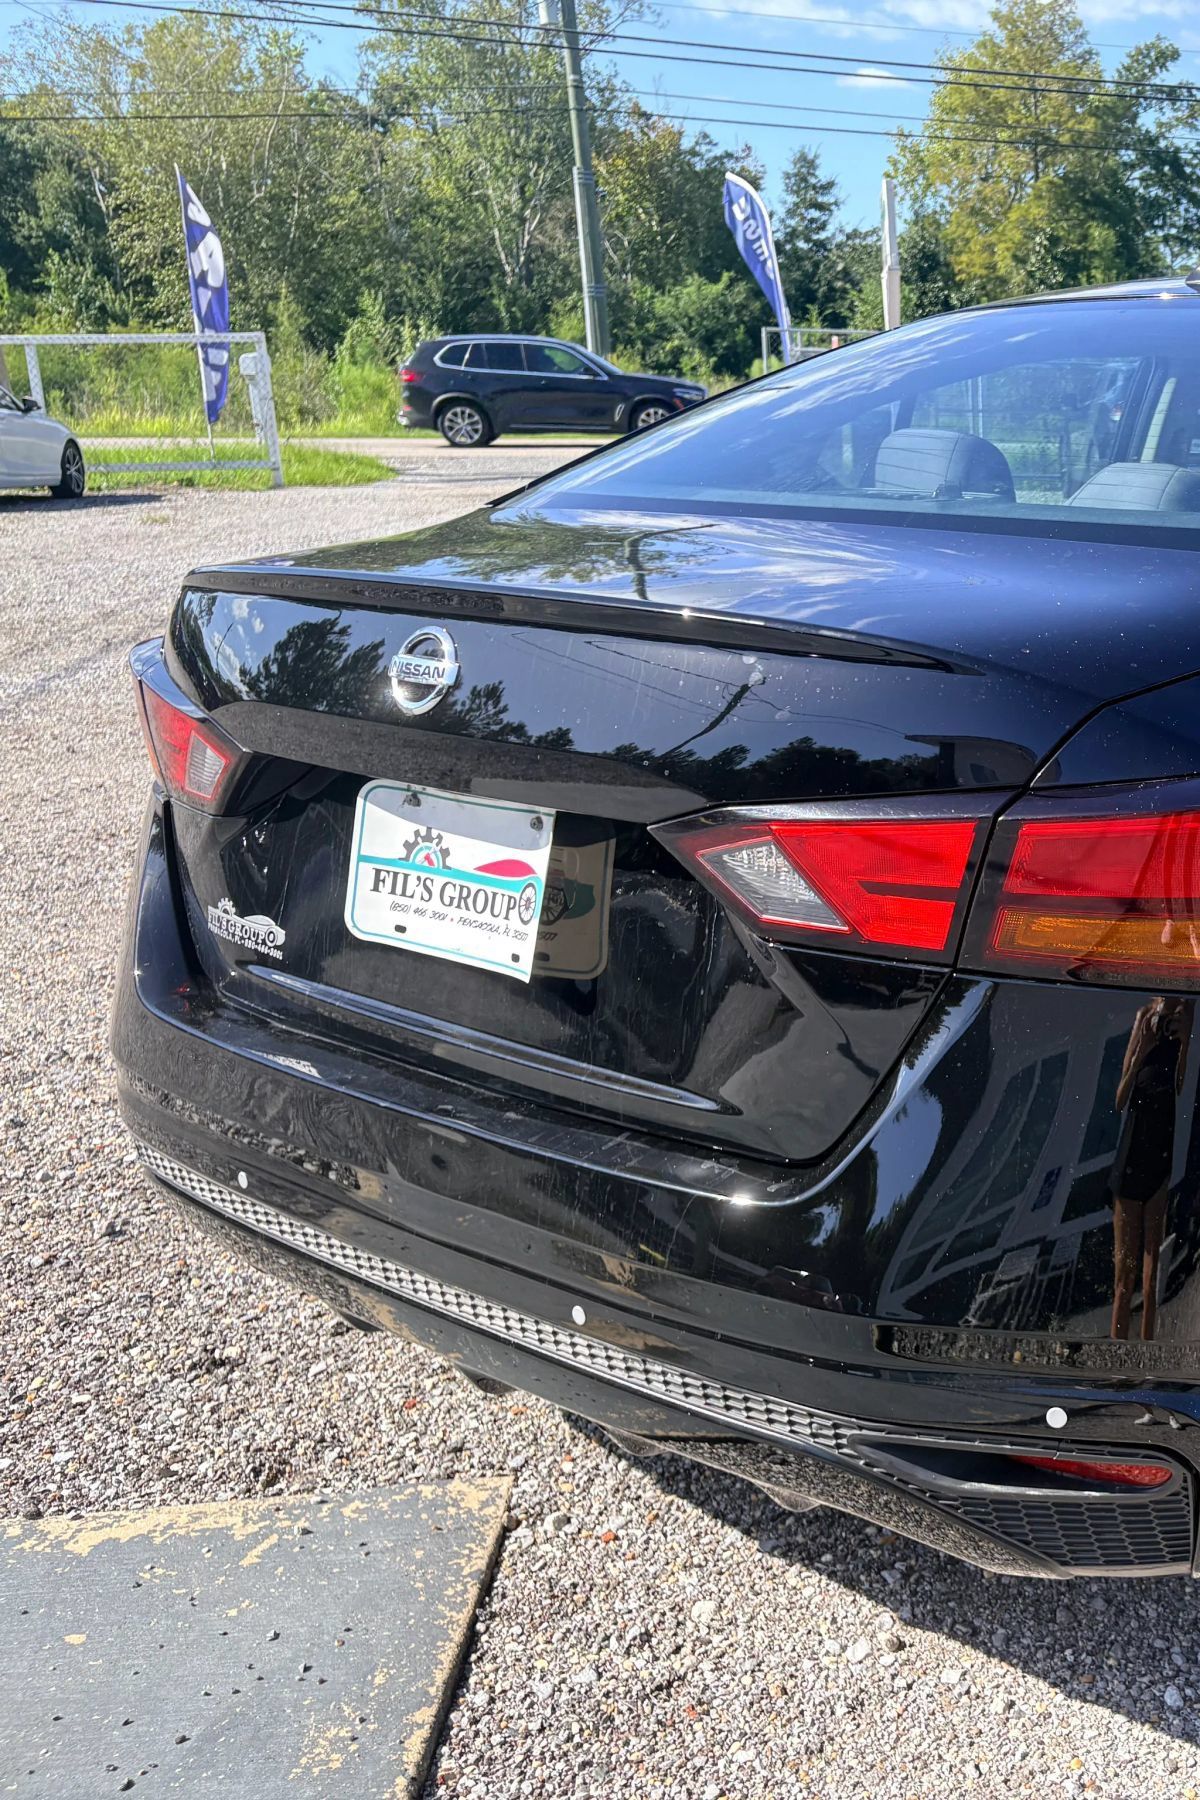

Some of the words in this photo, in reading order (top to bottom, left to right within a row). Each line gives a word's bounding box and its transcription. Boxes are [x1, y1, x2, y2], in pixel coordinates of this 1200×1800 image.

[391, 659, 446, 679] NISSAN
[370, 867, 434, 902] FIL'S
[439, 880, 517, 921] GROUP
[228, 921, 265, 943] GROUP
